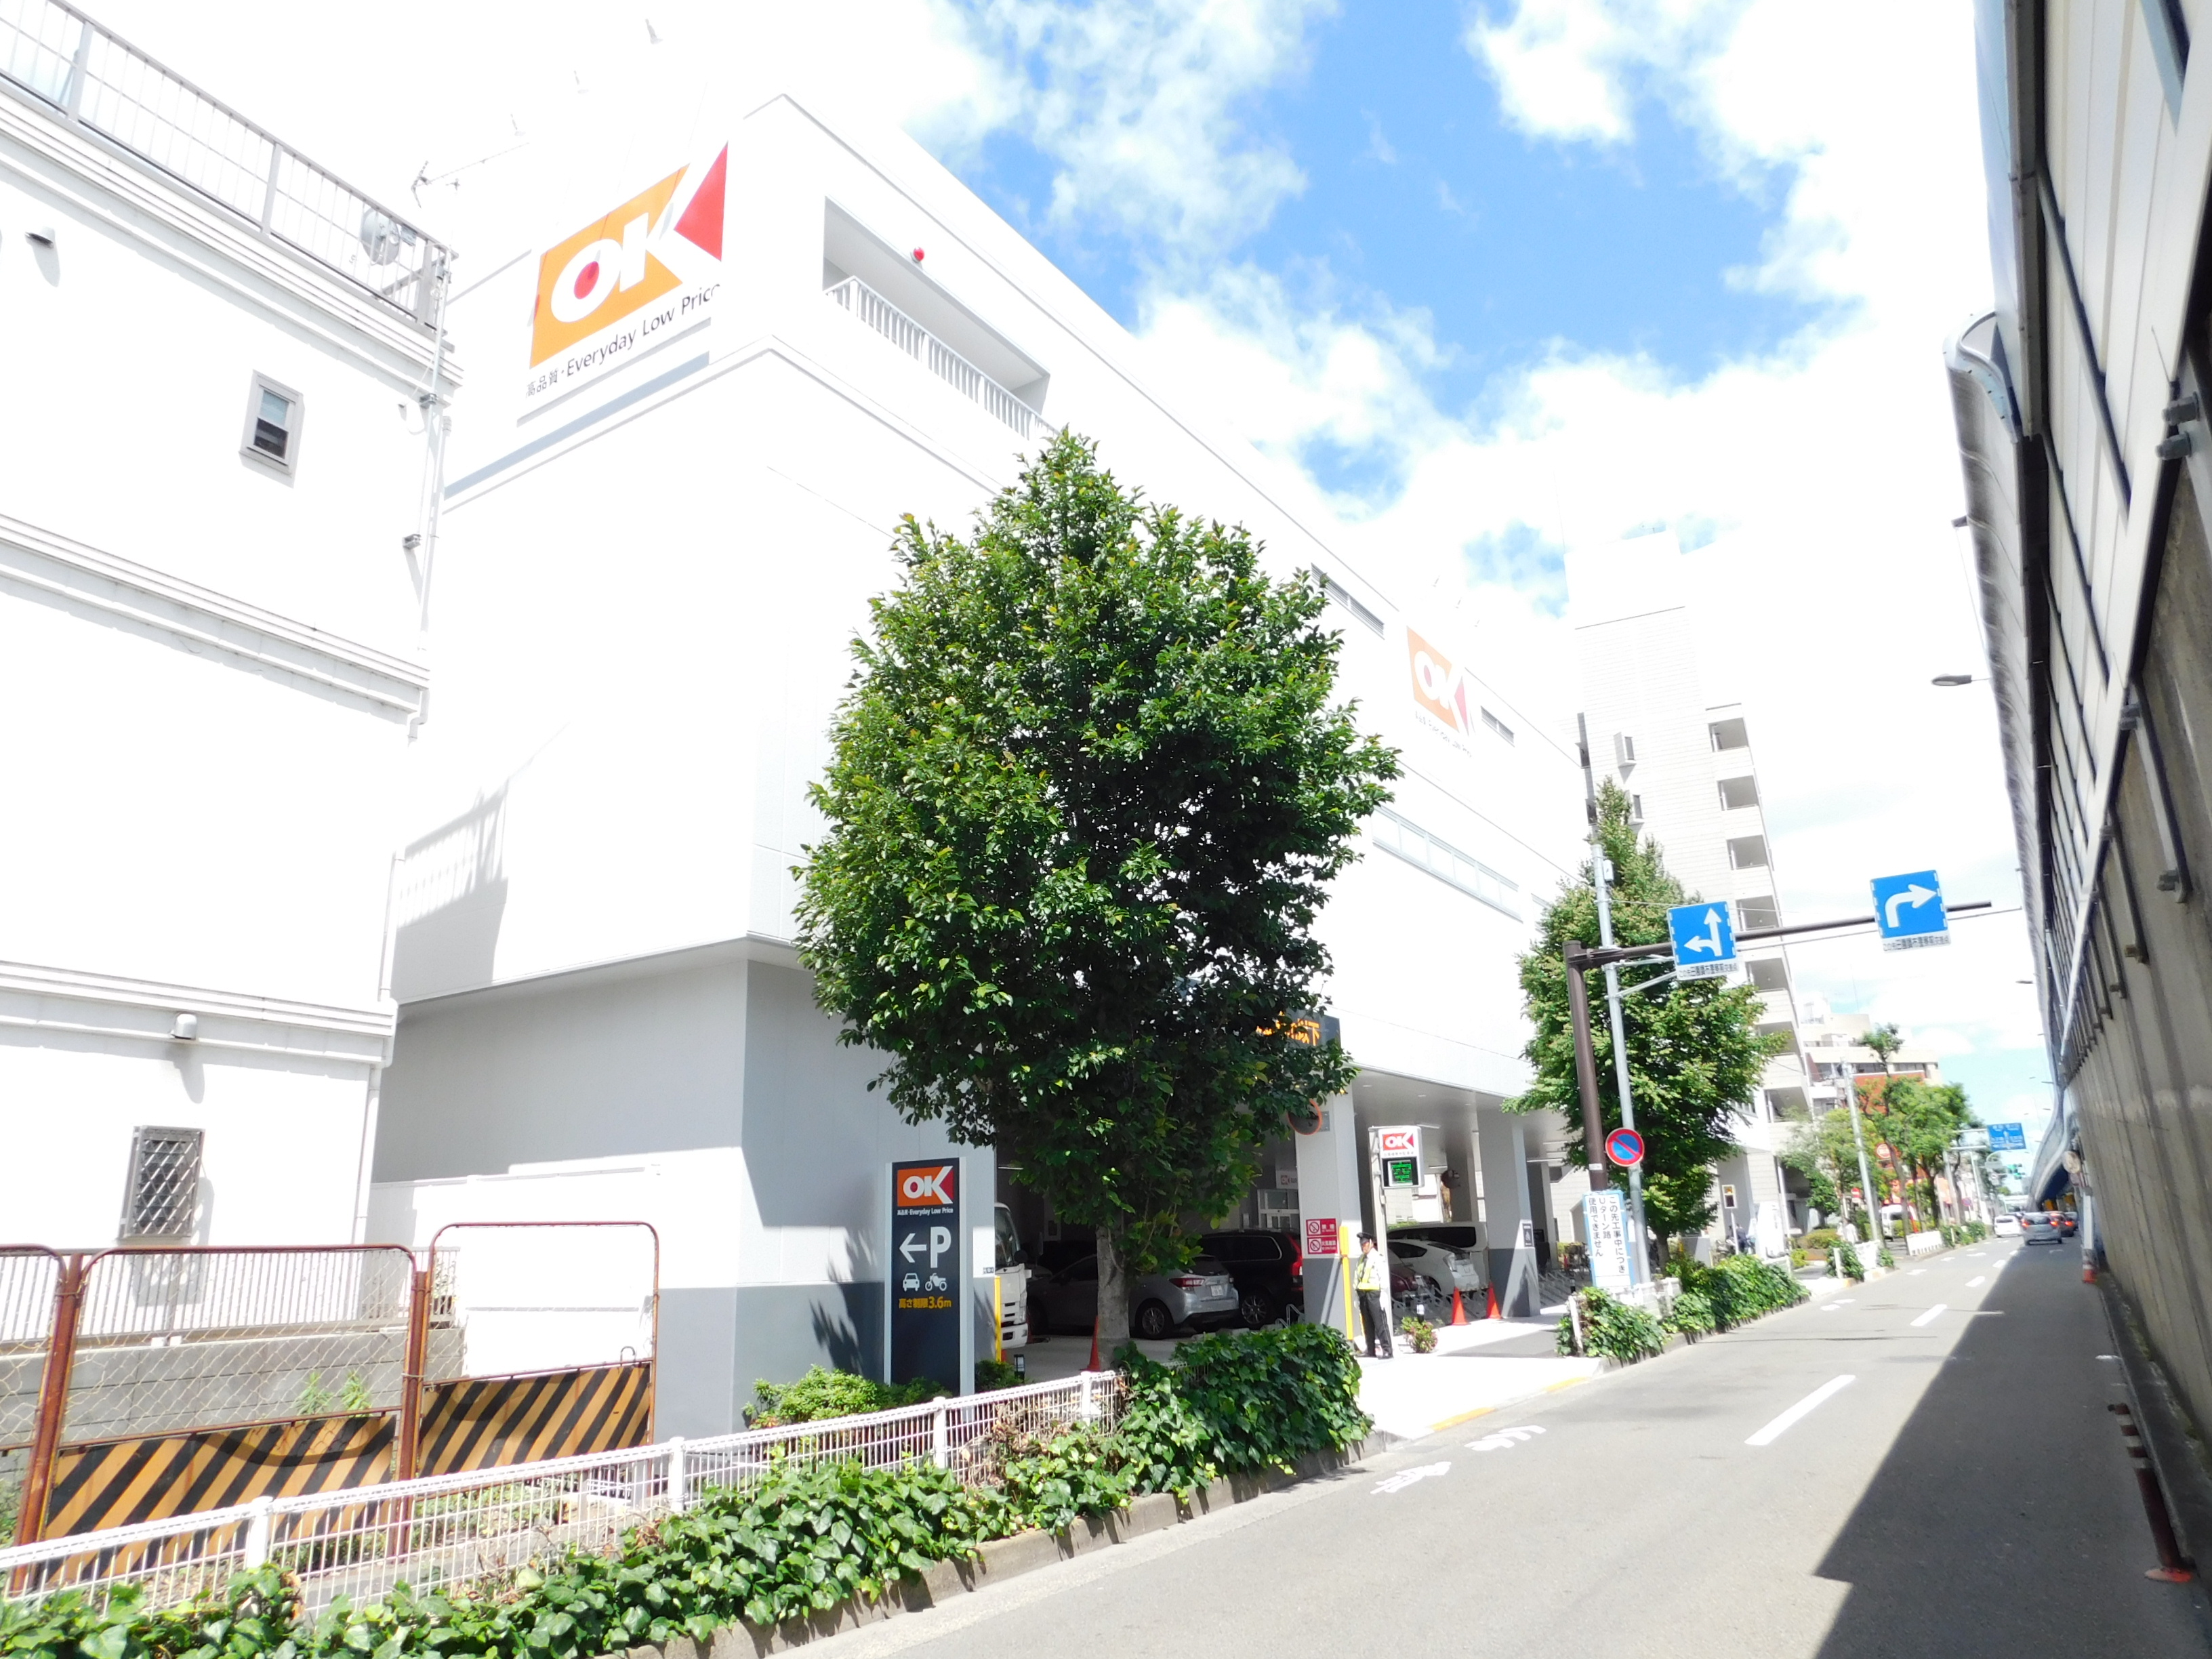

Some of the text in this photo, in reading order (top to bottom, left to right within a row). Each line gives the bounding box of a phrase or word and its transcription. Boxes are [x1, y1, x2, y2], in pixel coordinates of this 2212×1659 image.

[550, 143, 727, 323] OK
[642, 307, 675, 337] Low
[1414, 651, 1469, 736] OK
[1385, 1132, 1414, 1149] OK
[903, 1166, 954, 1204] OK
[1589, 1197, 1603, 1257] 使用できません
[1599, 1197, 1612, 1240] Uターン路
[1610, 1196, 1625, 1273] この先工事中につき
[930, 1226, 951, 1268] P
